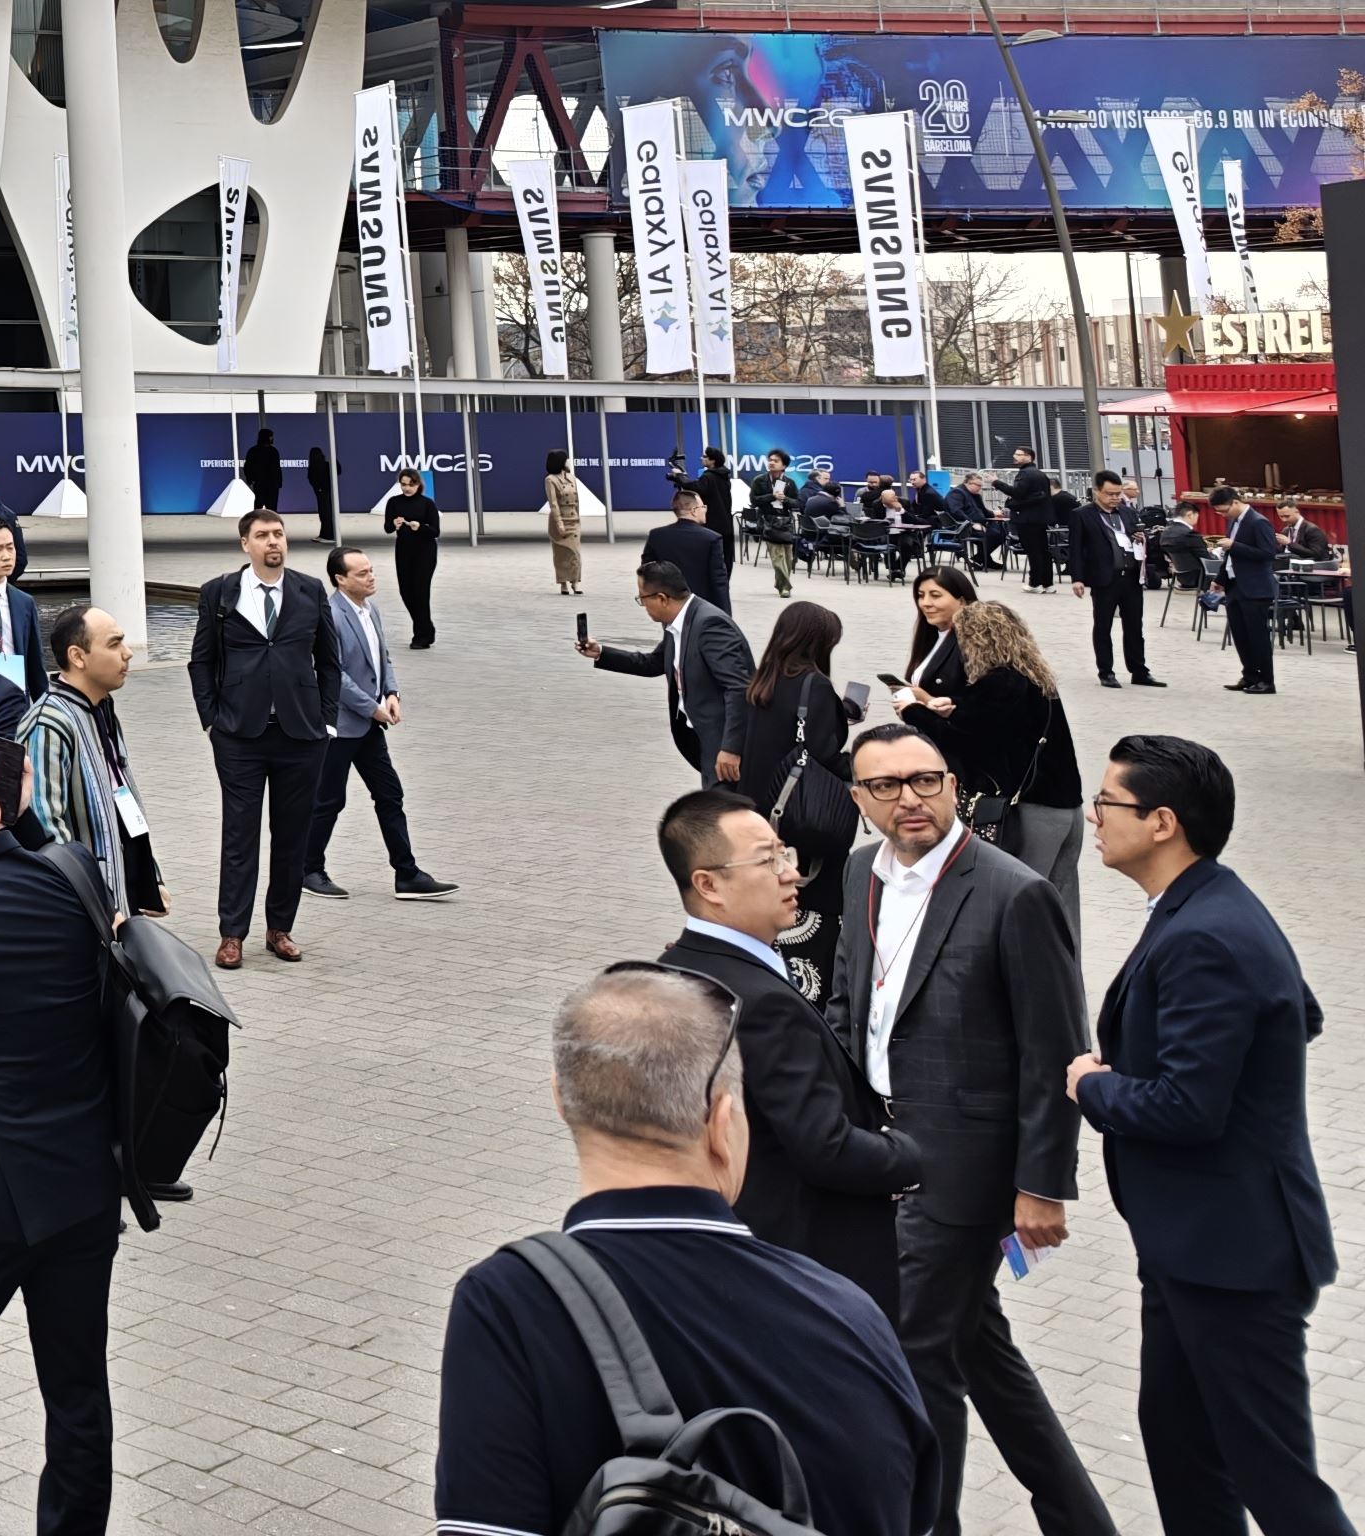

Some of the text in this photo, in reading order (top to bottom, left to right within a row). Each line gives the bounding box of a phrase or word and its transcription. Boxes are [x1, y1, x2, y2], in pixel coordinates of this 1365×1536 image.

[920, 80, 970, 133] 20 YEARS
[724, 108, 853, 128] MWC26
[1234, 109, 1255, 128] BN
[1259, 109, 1275, 128] IN
[924, 139, 972, 152] BARCELONA
[380, 453, 492, 472] MWC26
[589, 458, 599, 467] THE
[622, 458, 629, 467] OF
[630, 458, 666, 467] CONNECTION
